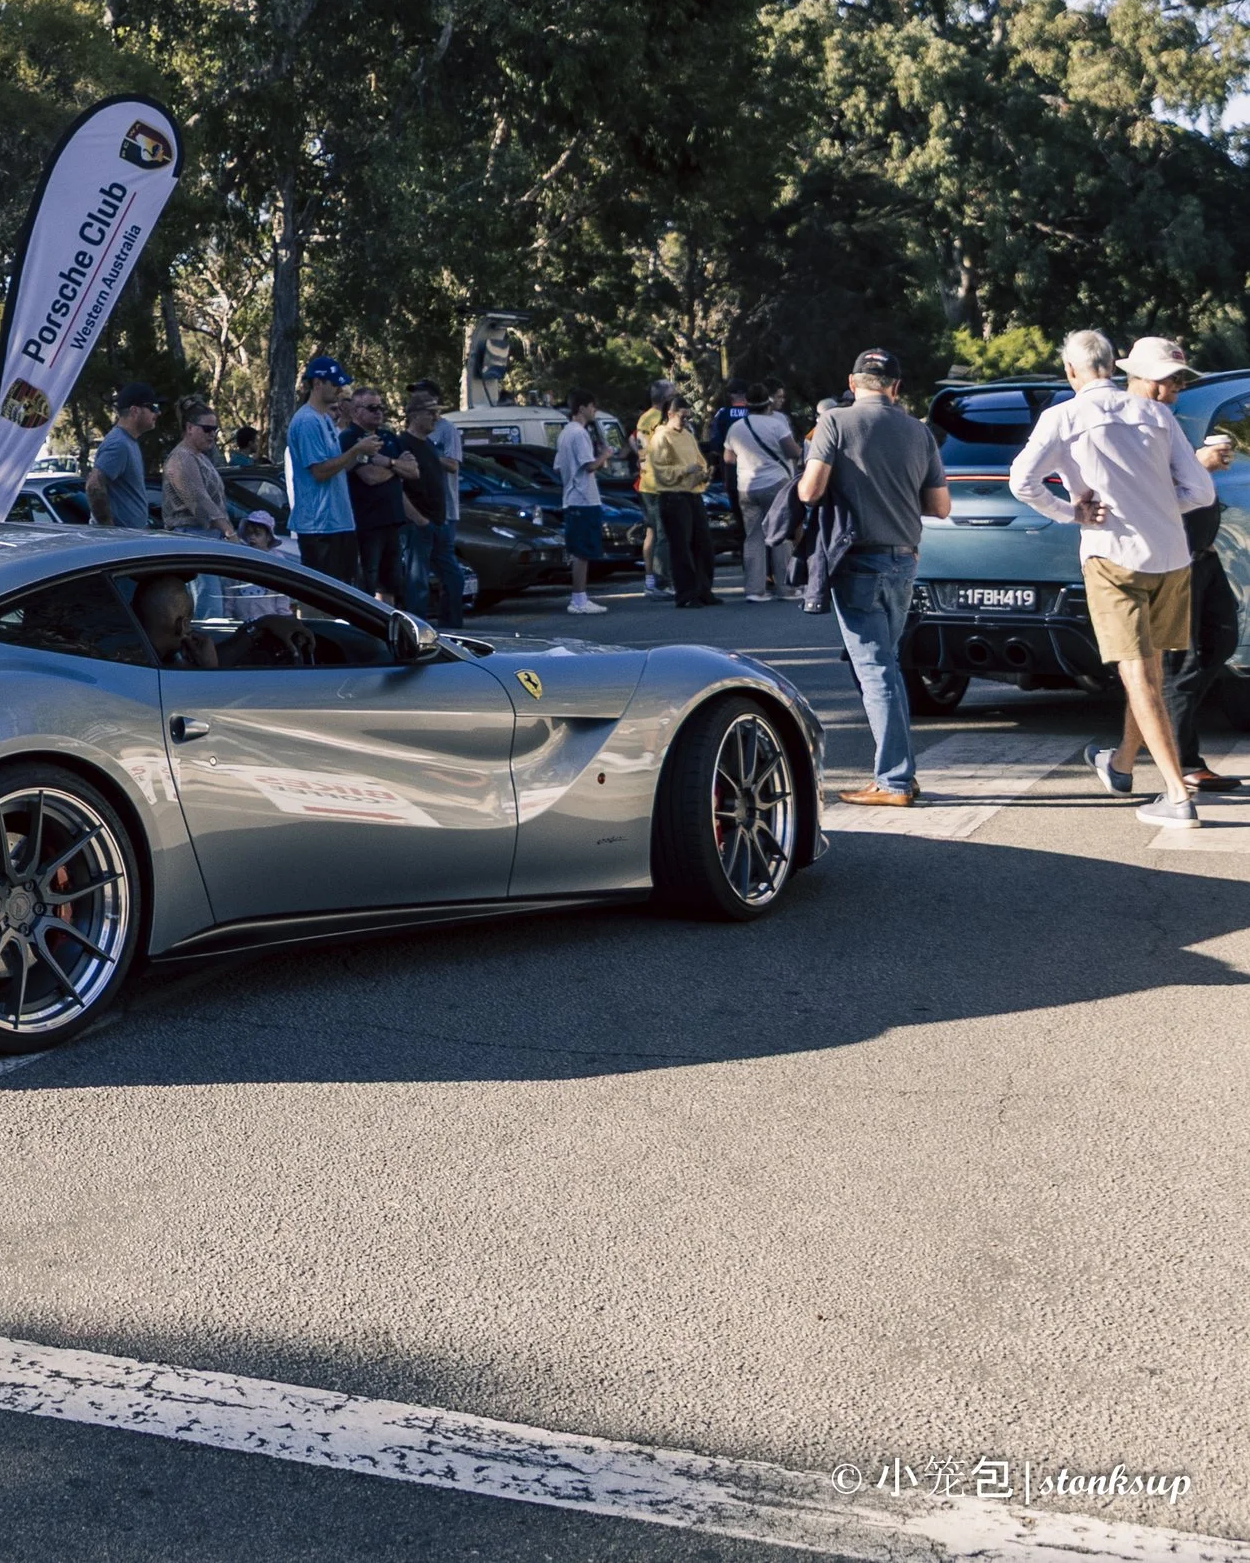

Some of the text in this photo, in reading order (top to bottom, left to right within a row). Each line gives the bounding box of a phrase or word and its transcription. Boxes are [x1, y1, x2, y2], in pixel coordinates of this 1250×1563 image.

[22, 181, 128, 365] Porsche Club
[70, 224, 142, 351] Western Australia
[967, 589, 1034, 606] 1FBH419
